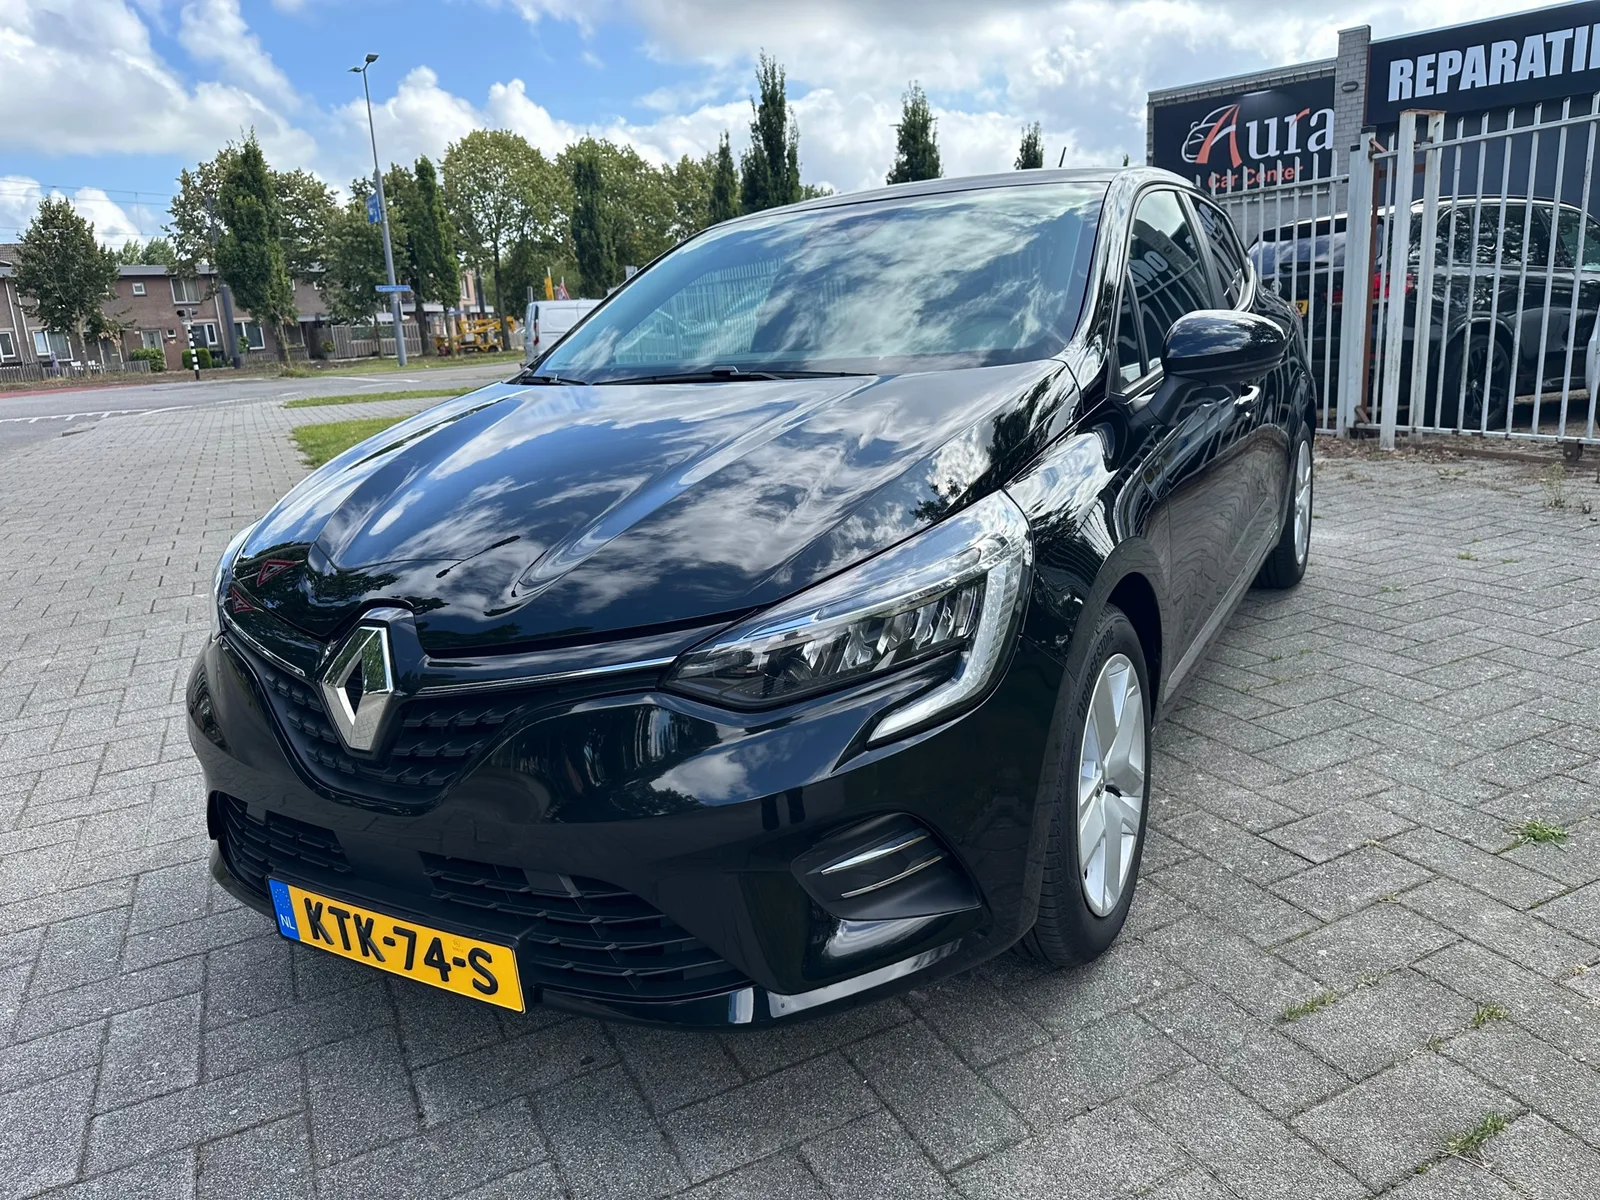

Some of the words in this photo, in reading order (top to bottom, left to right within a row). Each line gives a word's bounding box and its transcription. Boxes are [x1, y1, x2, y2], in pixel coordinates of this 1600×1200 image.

[1195, 104, 1335, 168] Aura
[1207, 173, 1238, 189] Car
[1244, 165, 1304, 185] Cene
[1076, 625, 1115, 721] BRIDGESTONE
[280, 913, 296, 930] NL
[304, 897, 499, 996] KTK-74-S
